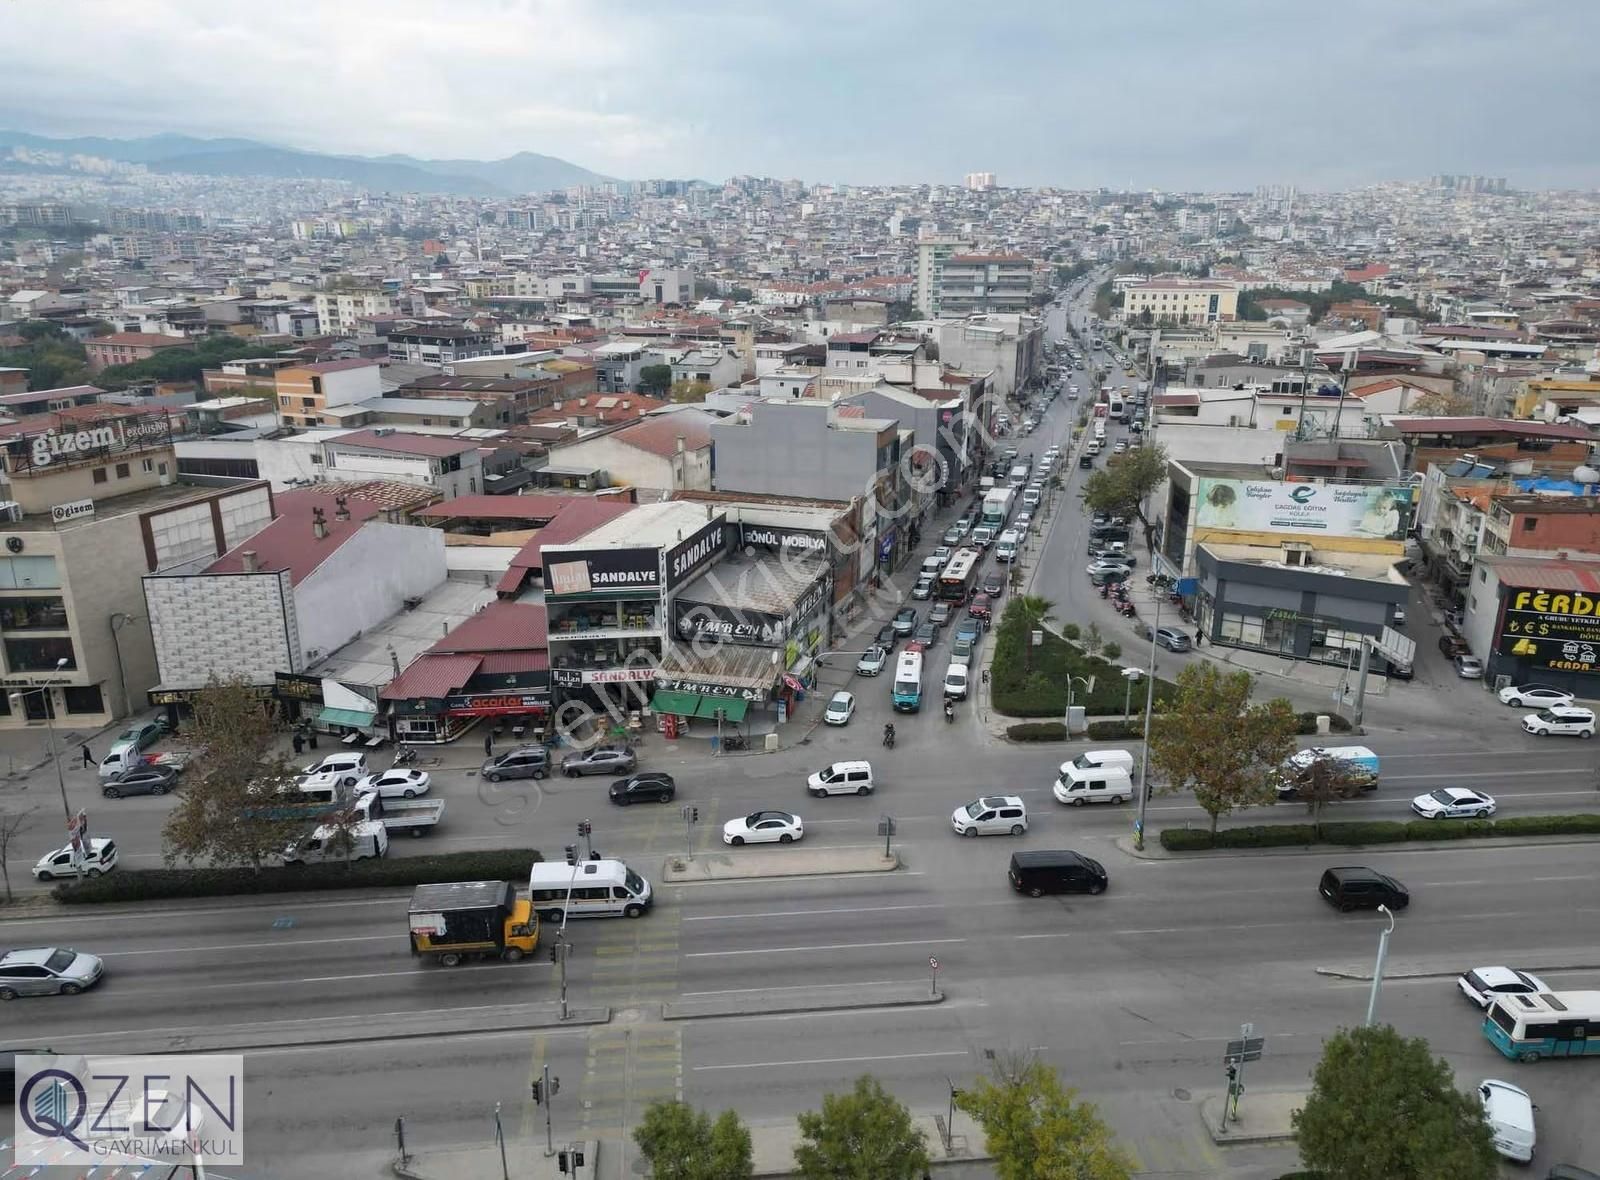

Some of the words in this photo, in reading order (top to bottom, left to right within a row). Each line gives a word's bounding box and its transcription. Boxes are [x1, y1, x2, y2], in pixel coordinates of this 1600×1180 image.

[32, 426, 118, 466] gizem
[126, 420, 169, 438] exclusive
[781, 534, 826, 550] MOBİLYA
[674, 527, 721, 577] SANDALYE
[592, 571, 656, 584] SANDALYE
[1515, 592, 1600, 617] FERD
[695, 618, 760, 636] İMREN
[1549, 660, 1590, 671] FERDA
[672, 680, 737, 696] İMREN
